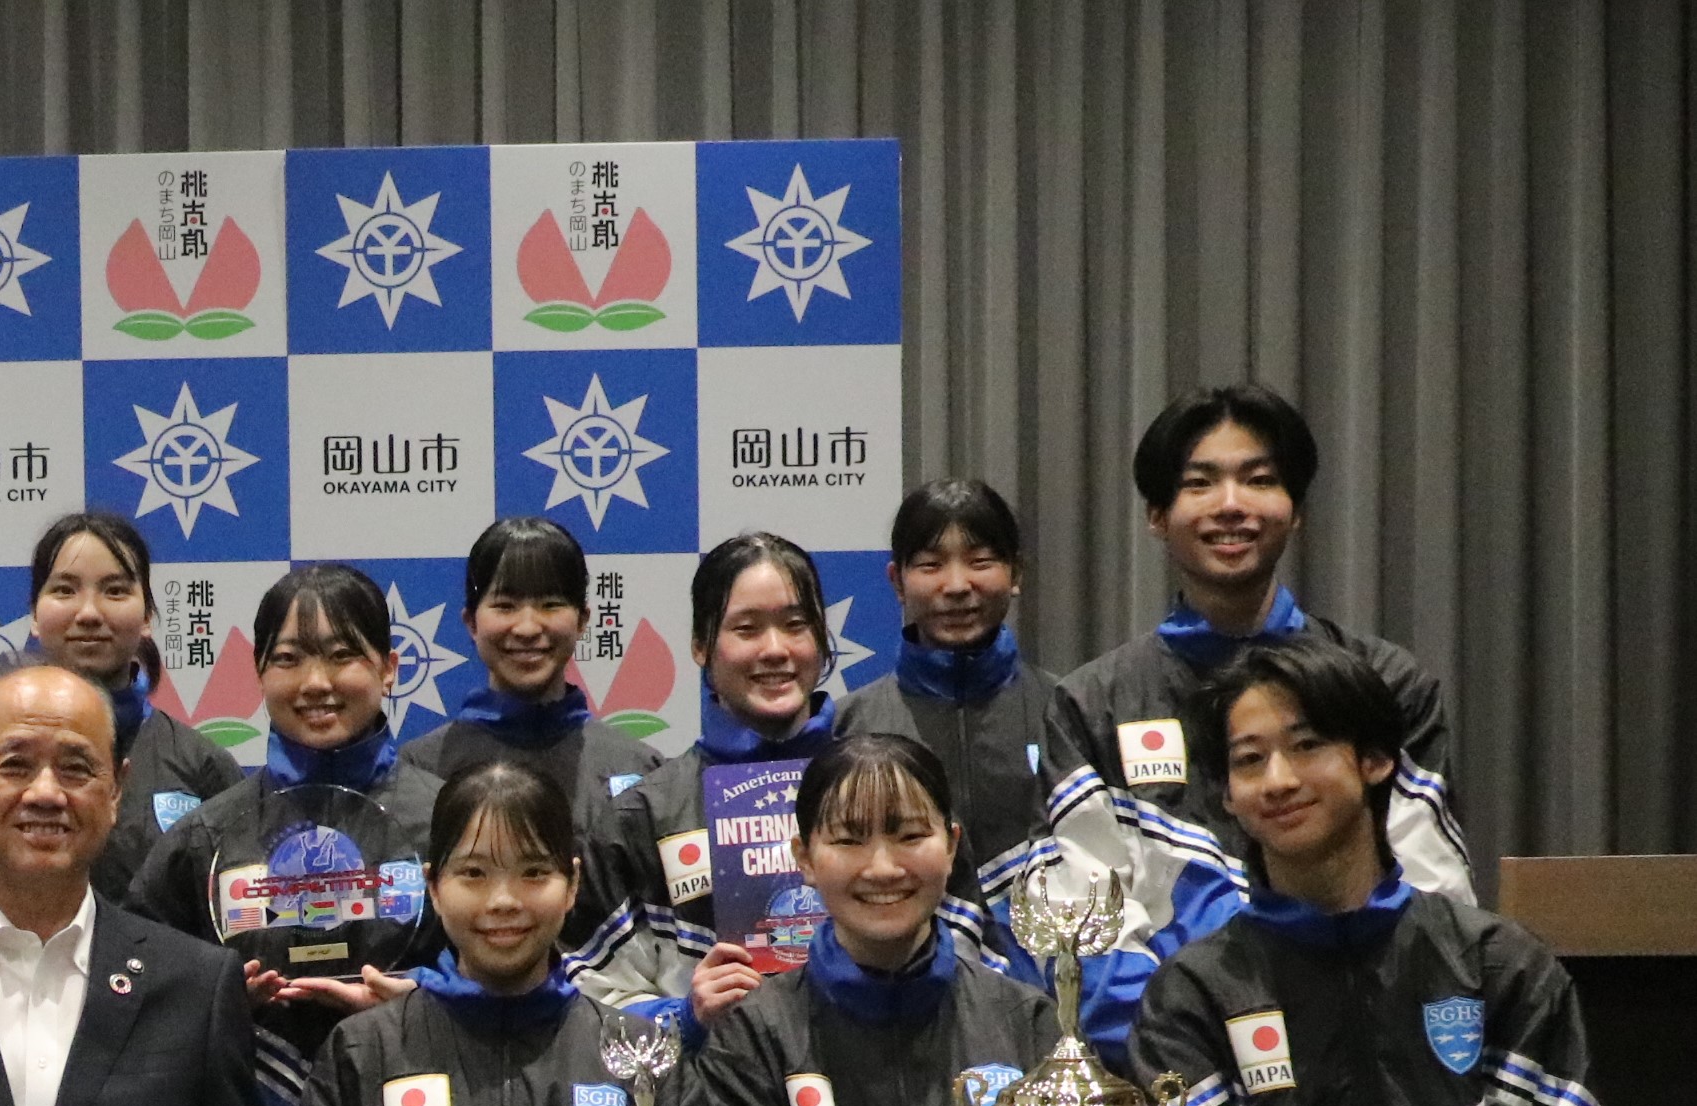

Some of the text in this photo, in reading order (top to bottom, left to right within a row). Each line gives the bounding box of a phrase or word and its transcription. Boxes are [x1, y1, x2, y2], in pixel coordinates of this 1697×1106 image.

[158, 171, 175, 260] のまち岡山
[181, 170, 208, 259] 桃太郎
[569, 161, 586, 250] のまち岡山
[592, 161, 619, 250] 桃太郎
[323, 433, 460, 476] 岡山市
[732, 426, 868, 469] 岡山市
[7, 488, 48, 503] CITY
[323, 479, 458, 495] OKAYAMA CITY
[731, 472, 865, 488] OKAYAMA CITY
[165, 580, 182, 670] のまち岡山
[186, 580, 214, 668] 桃太郎
[596, 572, 623, 660] 桃太郎
[722, 770, 802, 803] American
[1131, 762, 1182, 779] JAPAN
[715, 812, 800, 845] INTERNA
[381, 865, 417, 880] SGH
[742, 845, 801, 876] CHAM
[243, 875, 393, 898] COMPETITION
[673, 875, 711, 899] JAPA
[1429, 1005, 1481, 1023] SGHS
[982, 1071, 1022, 1087] GHS
[1248, 1064, 1291, 1088] JAPA
